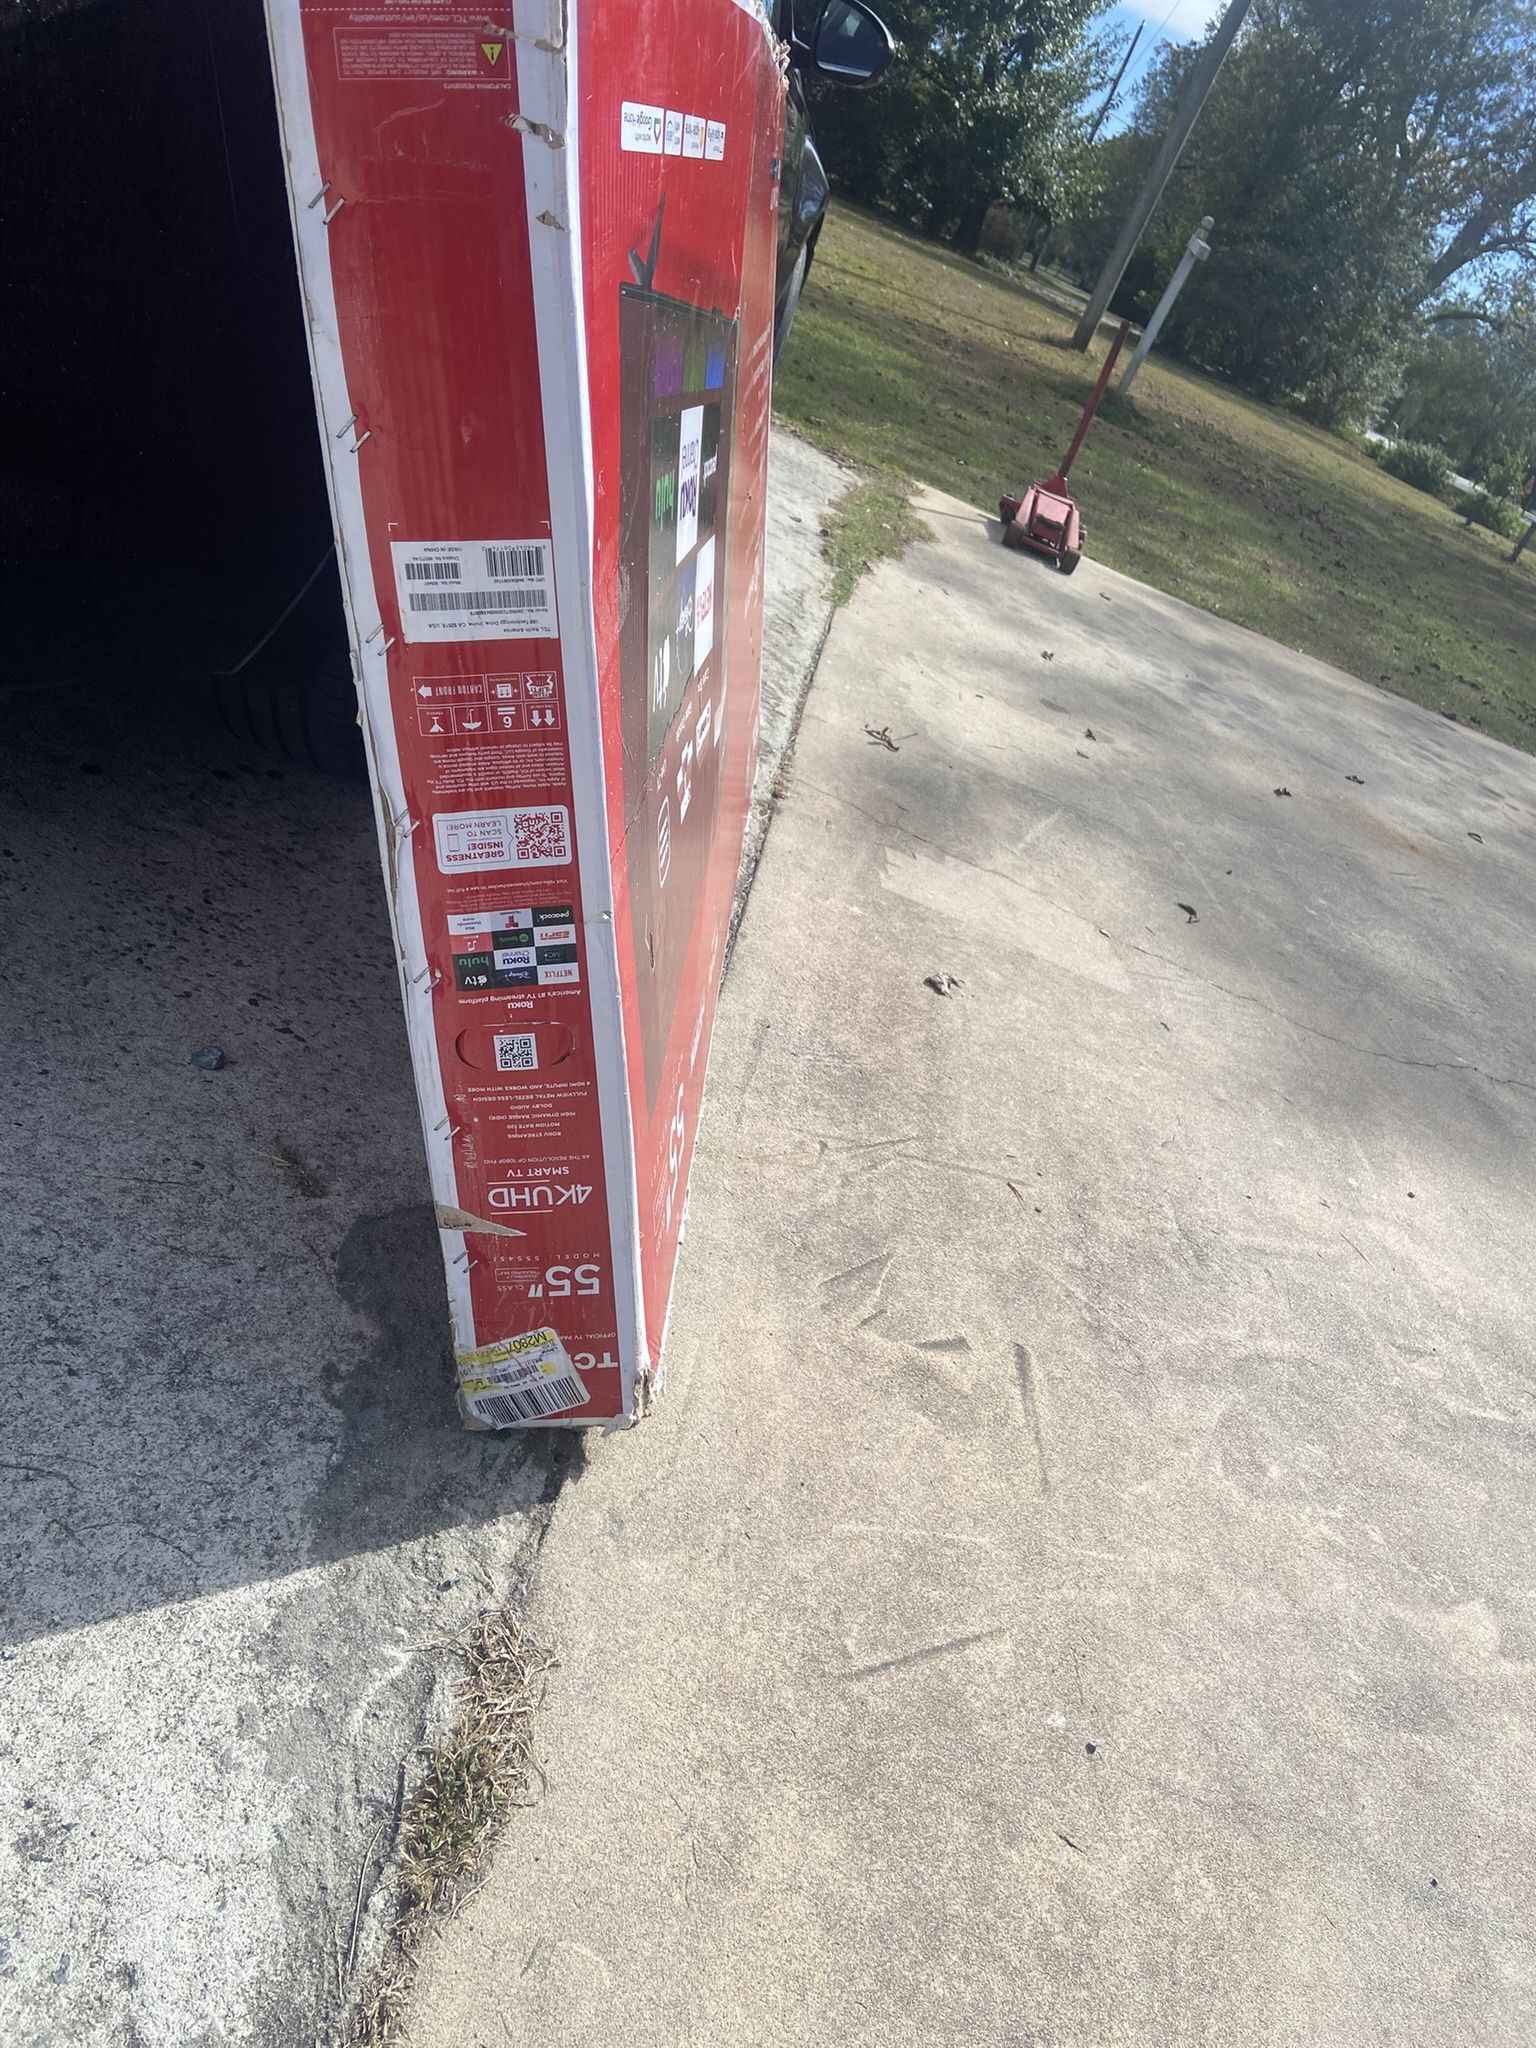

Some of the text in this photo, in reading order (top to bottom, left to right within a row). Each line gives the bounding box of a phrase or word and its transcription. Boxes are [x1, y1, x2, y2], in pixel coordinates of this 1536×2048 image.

[636, 111, 653, 131] Google
[434, 683, 482, 695] CARTON FRONT
[502, 716, 511, 727] 6
[445, 819, 500, 830] LEARN MORE!
[479, 828, 502, 836] SCAN
[467, 840, 503, 850] INSIDE!
[445, 849, 504, 861] GREATNESS
[539, 930, 569, 940] ESPN
[501, 949, 529, 957] Channel
[458, 955, 488, 968] hulu
[543, 968, 572, 978] NETFLIX
[490, 992, 525, 1002] streaming
[547, 988, 581, 997] America's
[457, 996, 488, 1005] platform
[506, 1131, 542, 1139] STREAMING
[527, 1154, 567, 1162] RESOLUTION
[505, 1165, 569, 1177] SMART TV
[496, 1283, 524, 1291] CLASS
[584, 1331, 615, 1339] OFFICIAL
[567, 1352, 618, 1370] TC
